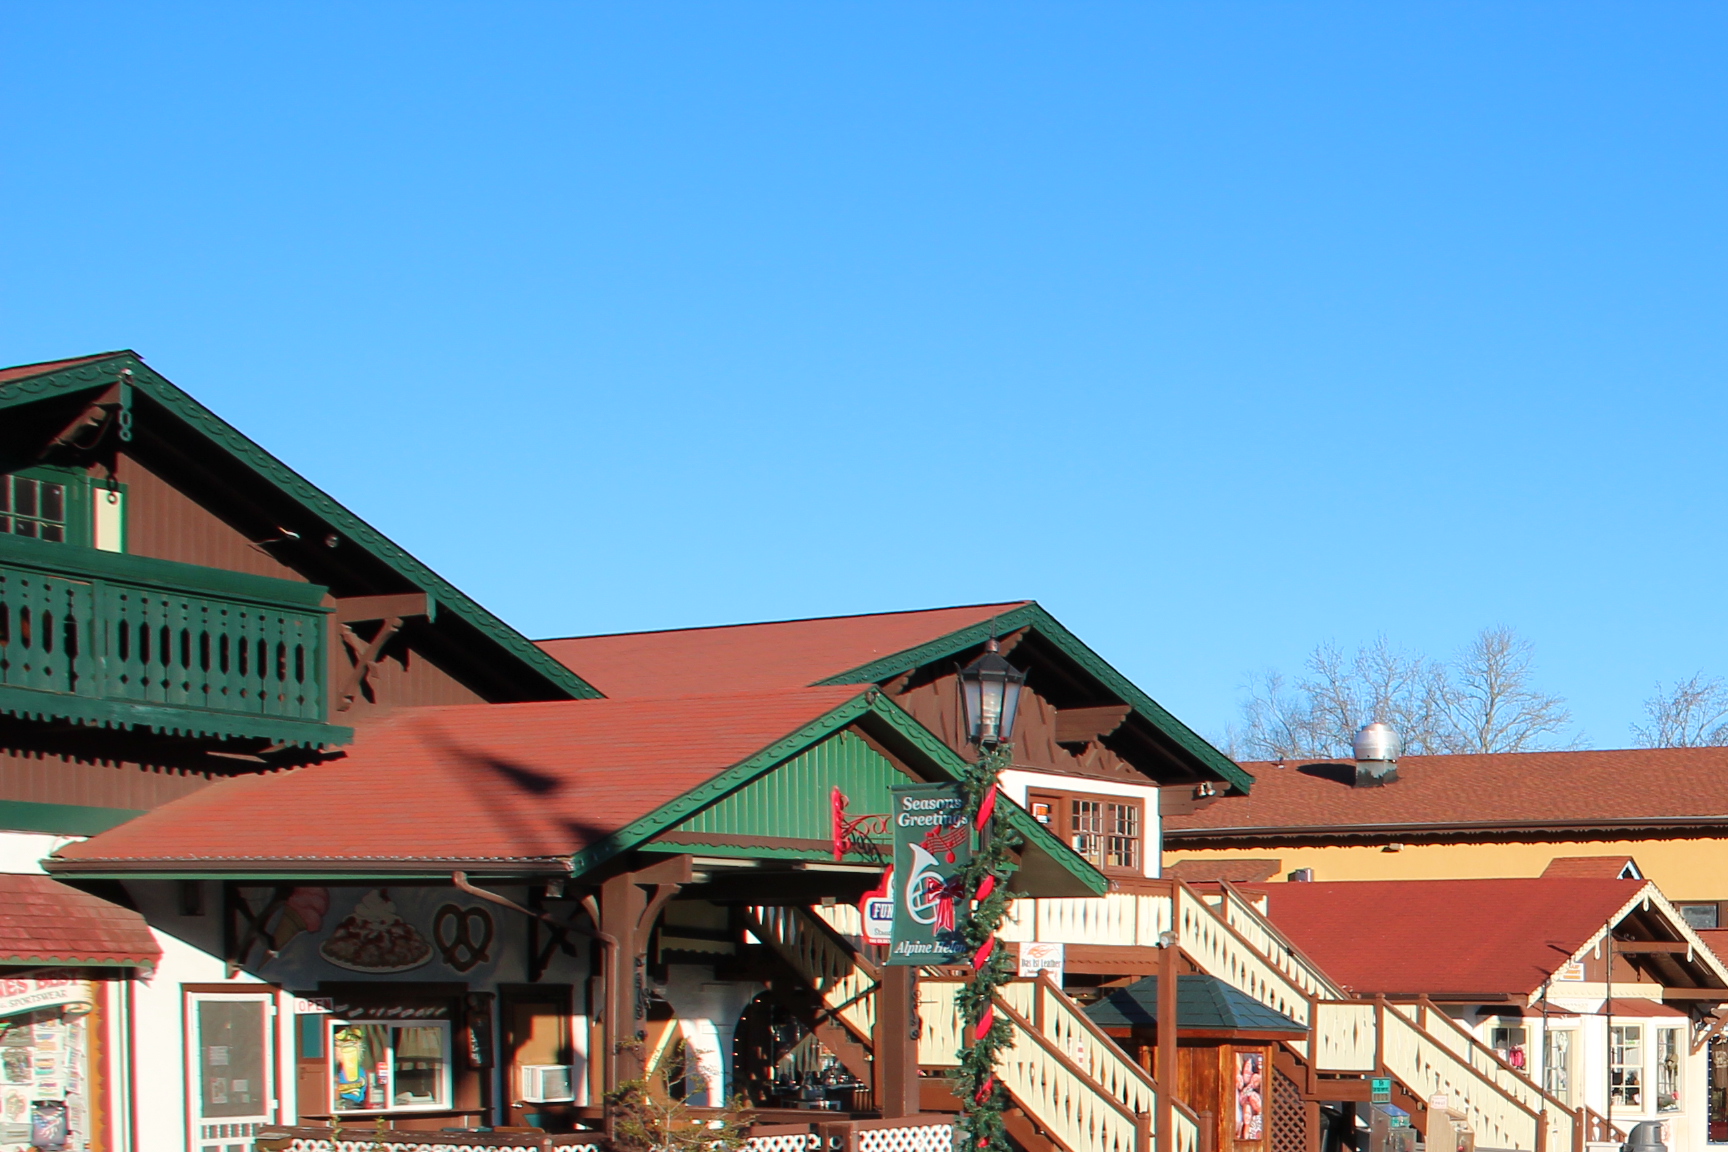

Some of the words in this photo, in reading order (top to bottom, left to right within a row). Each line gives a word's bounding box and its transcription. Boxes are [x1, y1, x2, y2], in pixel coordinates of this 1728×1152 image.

[897, 810, 969, 829] Greetings
[893, 940, 932, 957] Alpine
[298, 998, 332, 1012] OPEN
